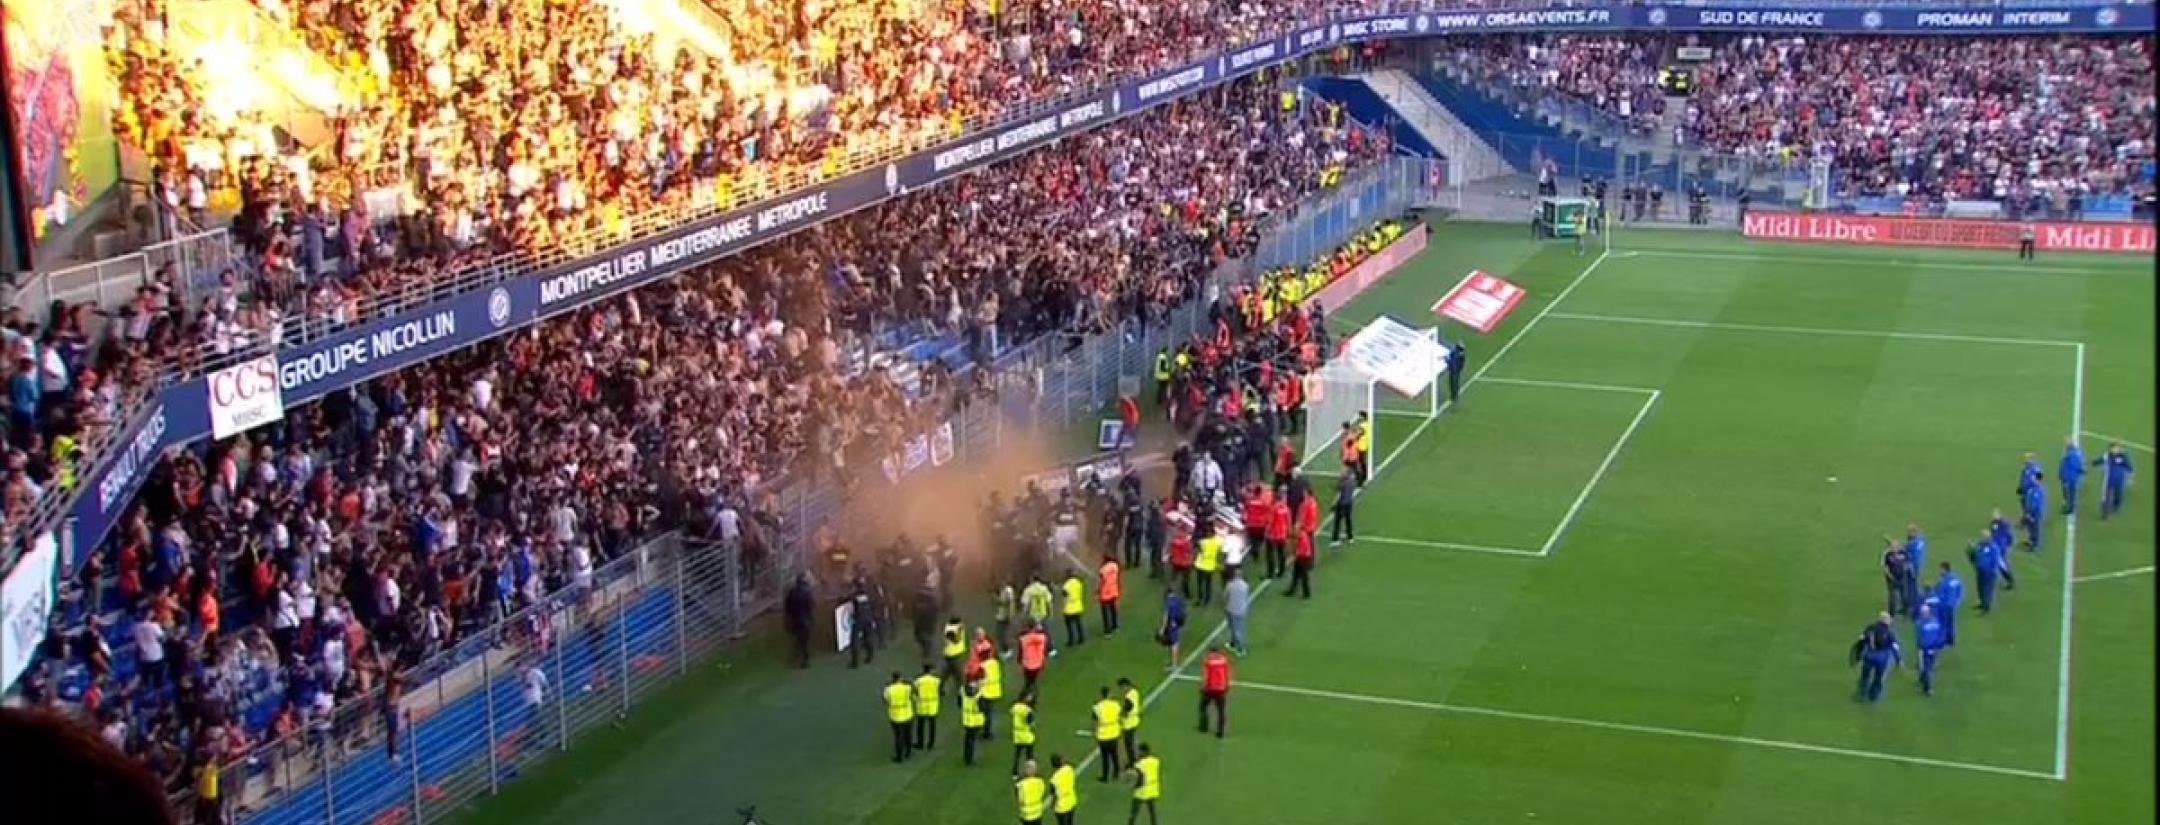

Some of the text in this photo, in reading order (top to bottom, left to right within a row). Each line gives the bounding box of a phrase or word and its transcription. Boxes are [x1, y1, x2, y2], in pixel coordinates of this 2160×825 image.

[1700, 11, 1824, 26] SUD DE FRANCE
[1918, 11, 2070, 26] PROMAN INTERIM
[1744, 214, 1877, 241] Midi Libre
[2046, 226, 2112, 249] Midi
[540, 250, 646, 304] MONTPELLIER
[758, 191, 828, 231] METROPOLE
[280, 310, 456, 389] GROUPE NICOLLIN
[213, 357, 277, 407] CCS
